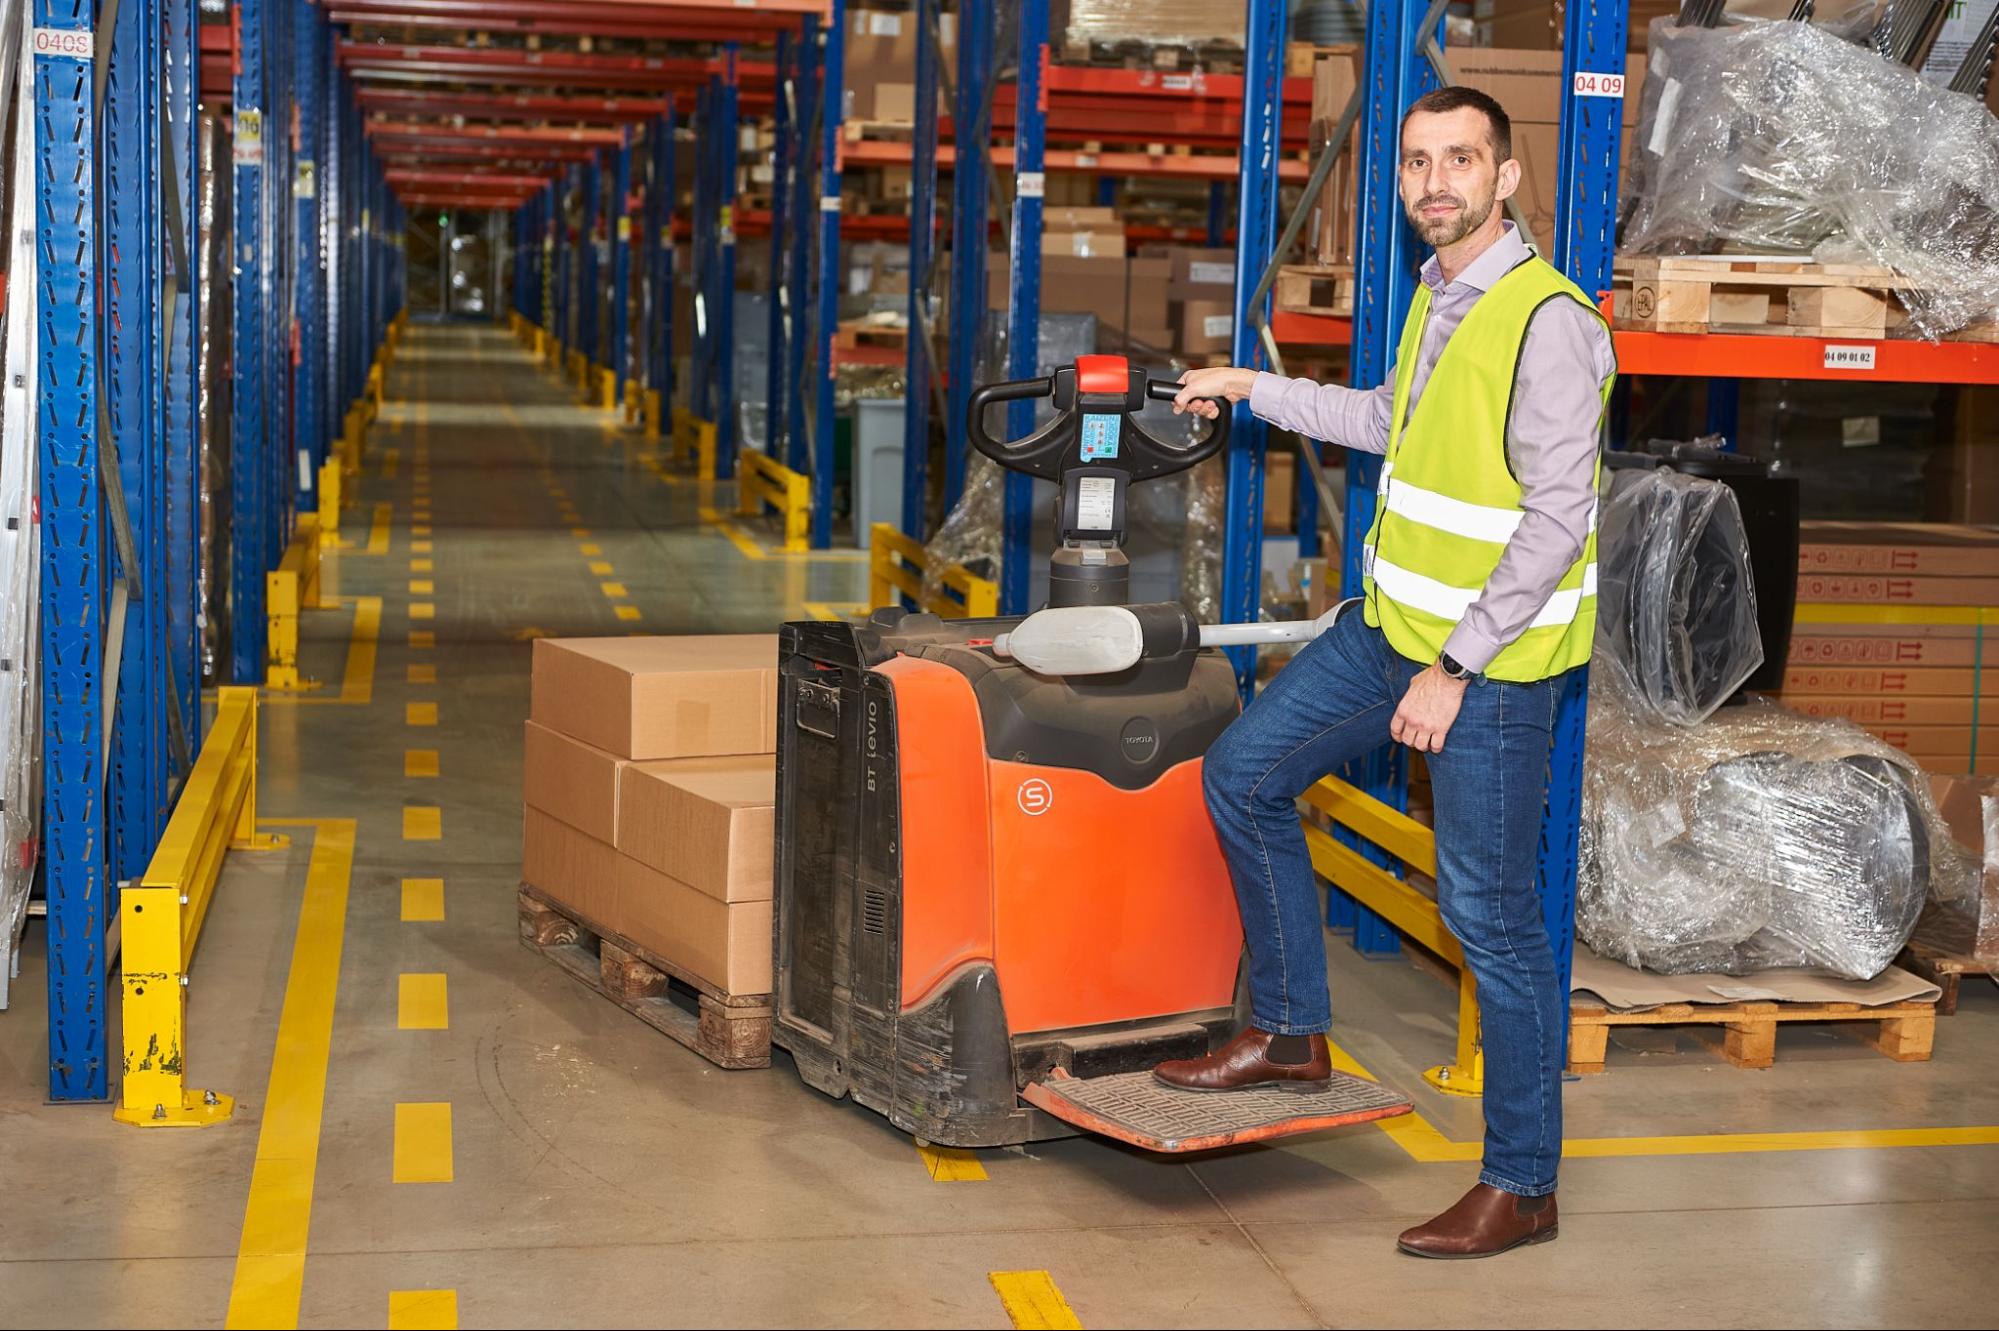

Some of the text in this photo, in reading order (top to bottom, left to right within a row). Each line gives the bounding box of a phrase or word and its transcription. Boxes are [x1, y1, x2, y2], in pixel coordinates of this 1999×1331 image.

[1575, 76, 1621, 93] 04 09
[1860, 353, 1870, 363] 02
[1124, 736, 1152, 744] TOYOTA
[867, 766, 876, 792] BT
